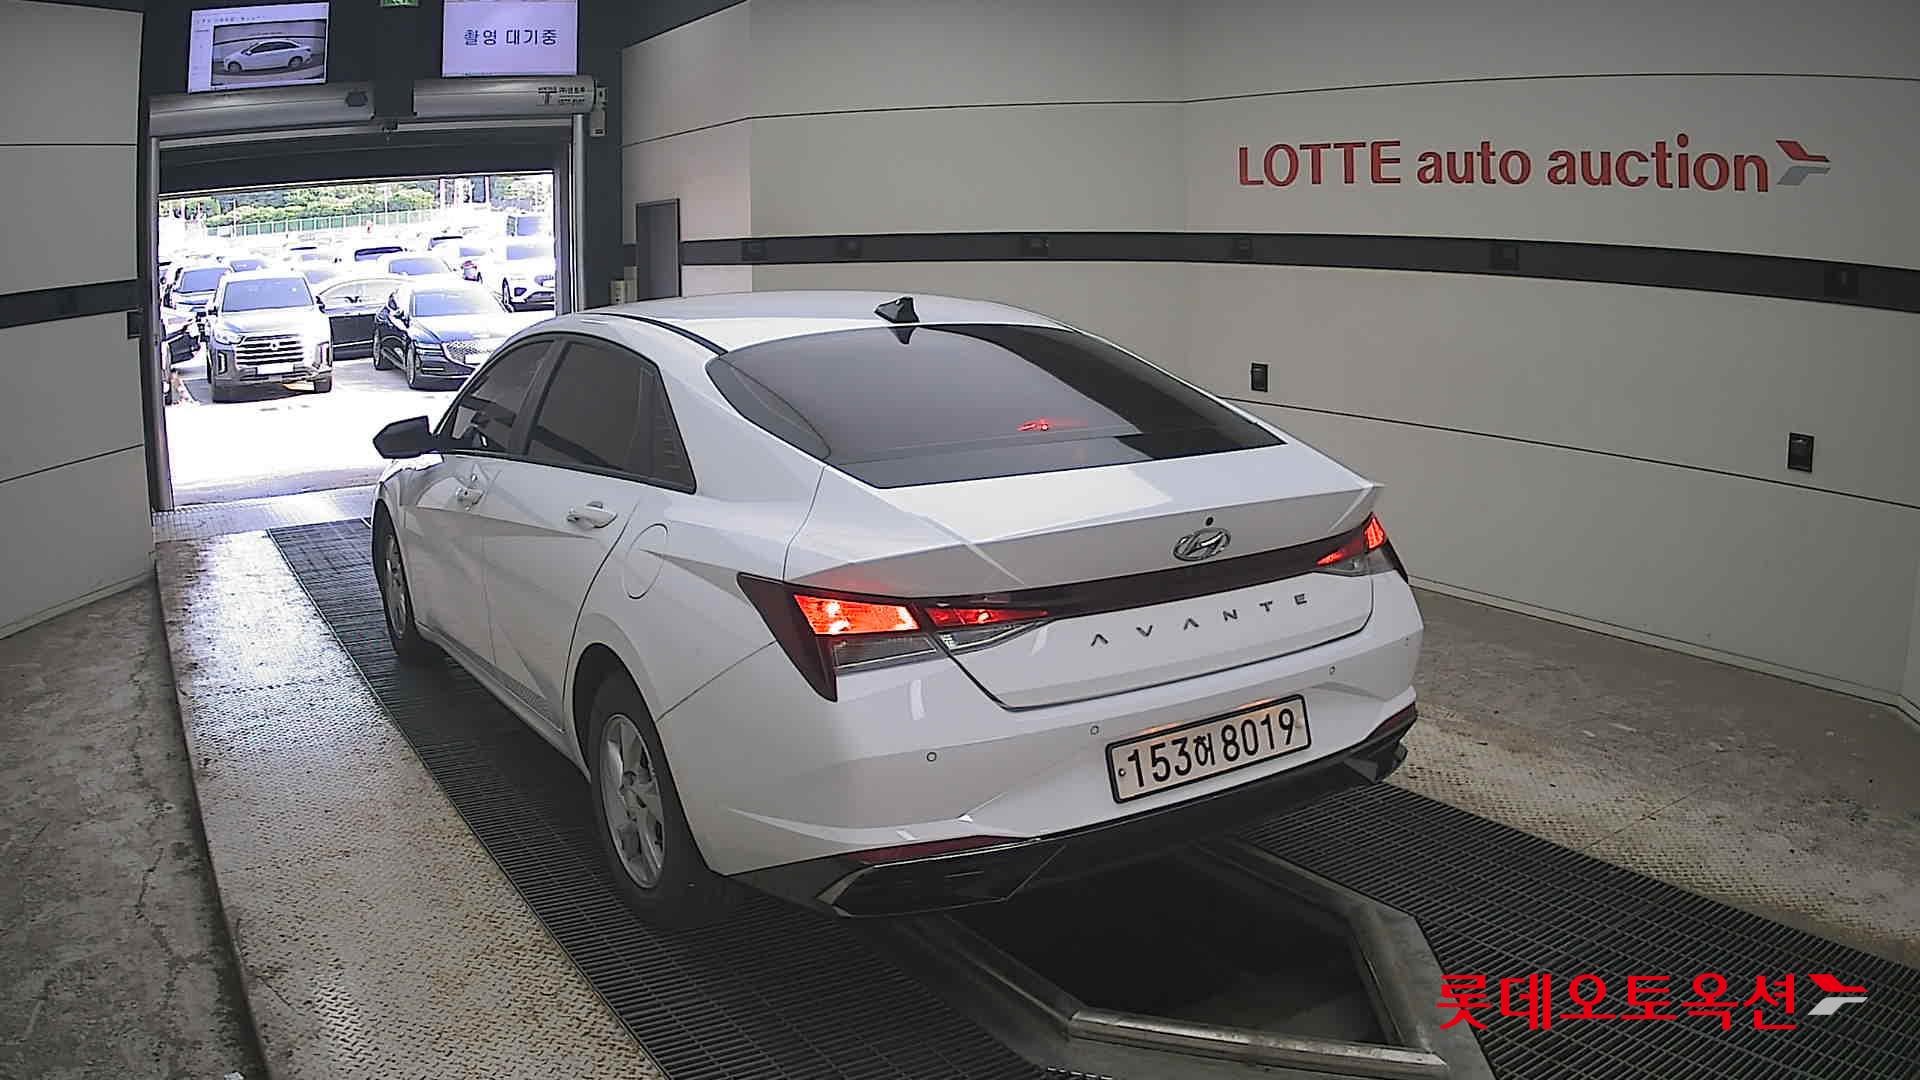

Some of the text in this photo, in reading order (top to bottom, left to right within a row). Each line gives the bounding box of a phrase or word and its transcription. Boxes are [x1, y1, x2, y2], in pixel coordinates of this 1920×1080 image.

[464, 29, 558, 46] 촬영 대기중
[1239, 133, 1769, 193] LOTTE auto auction
[1091, 593, 1308, 647] AVANTE
